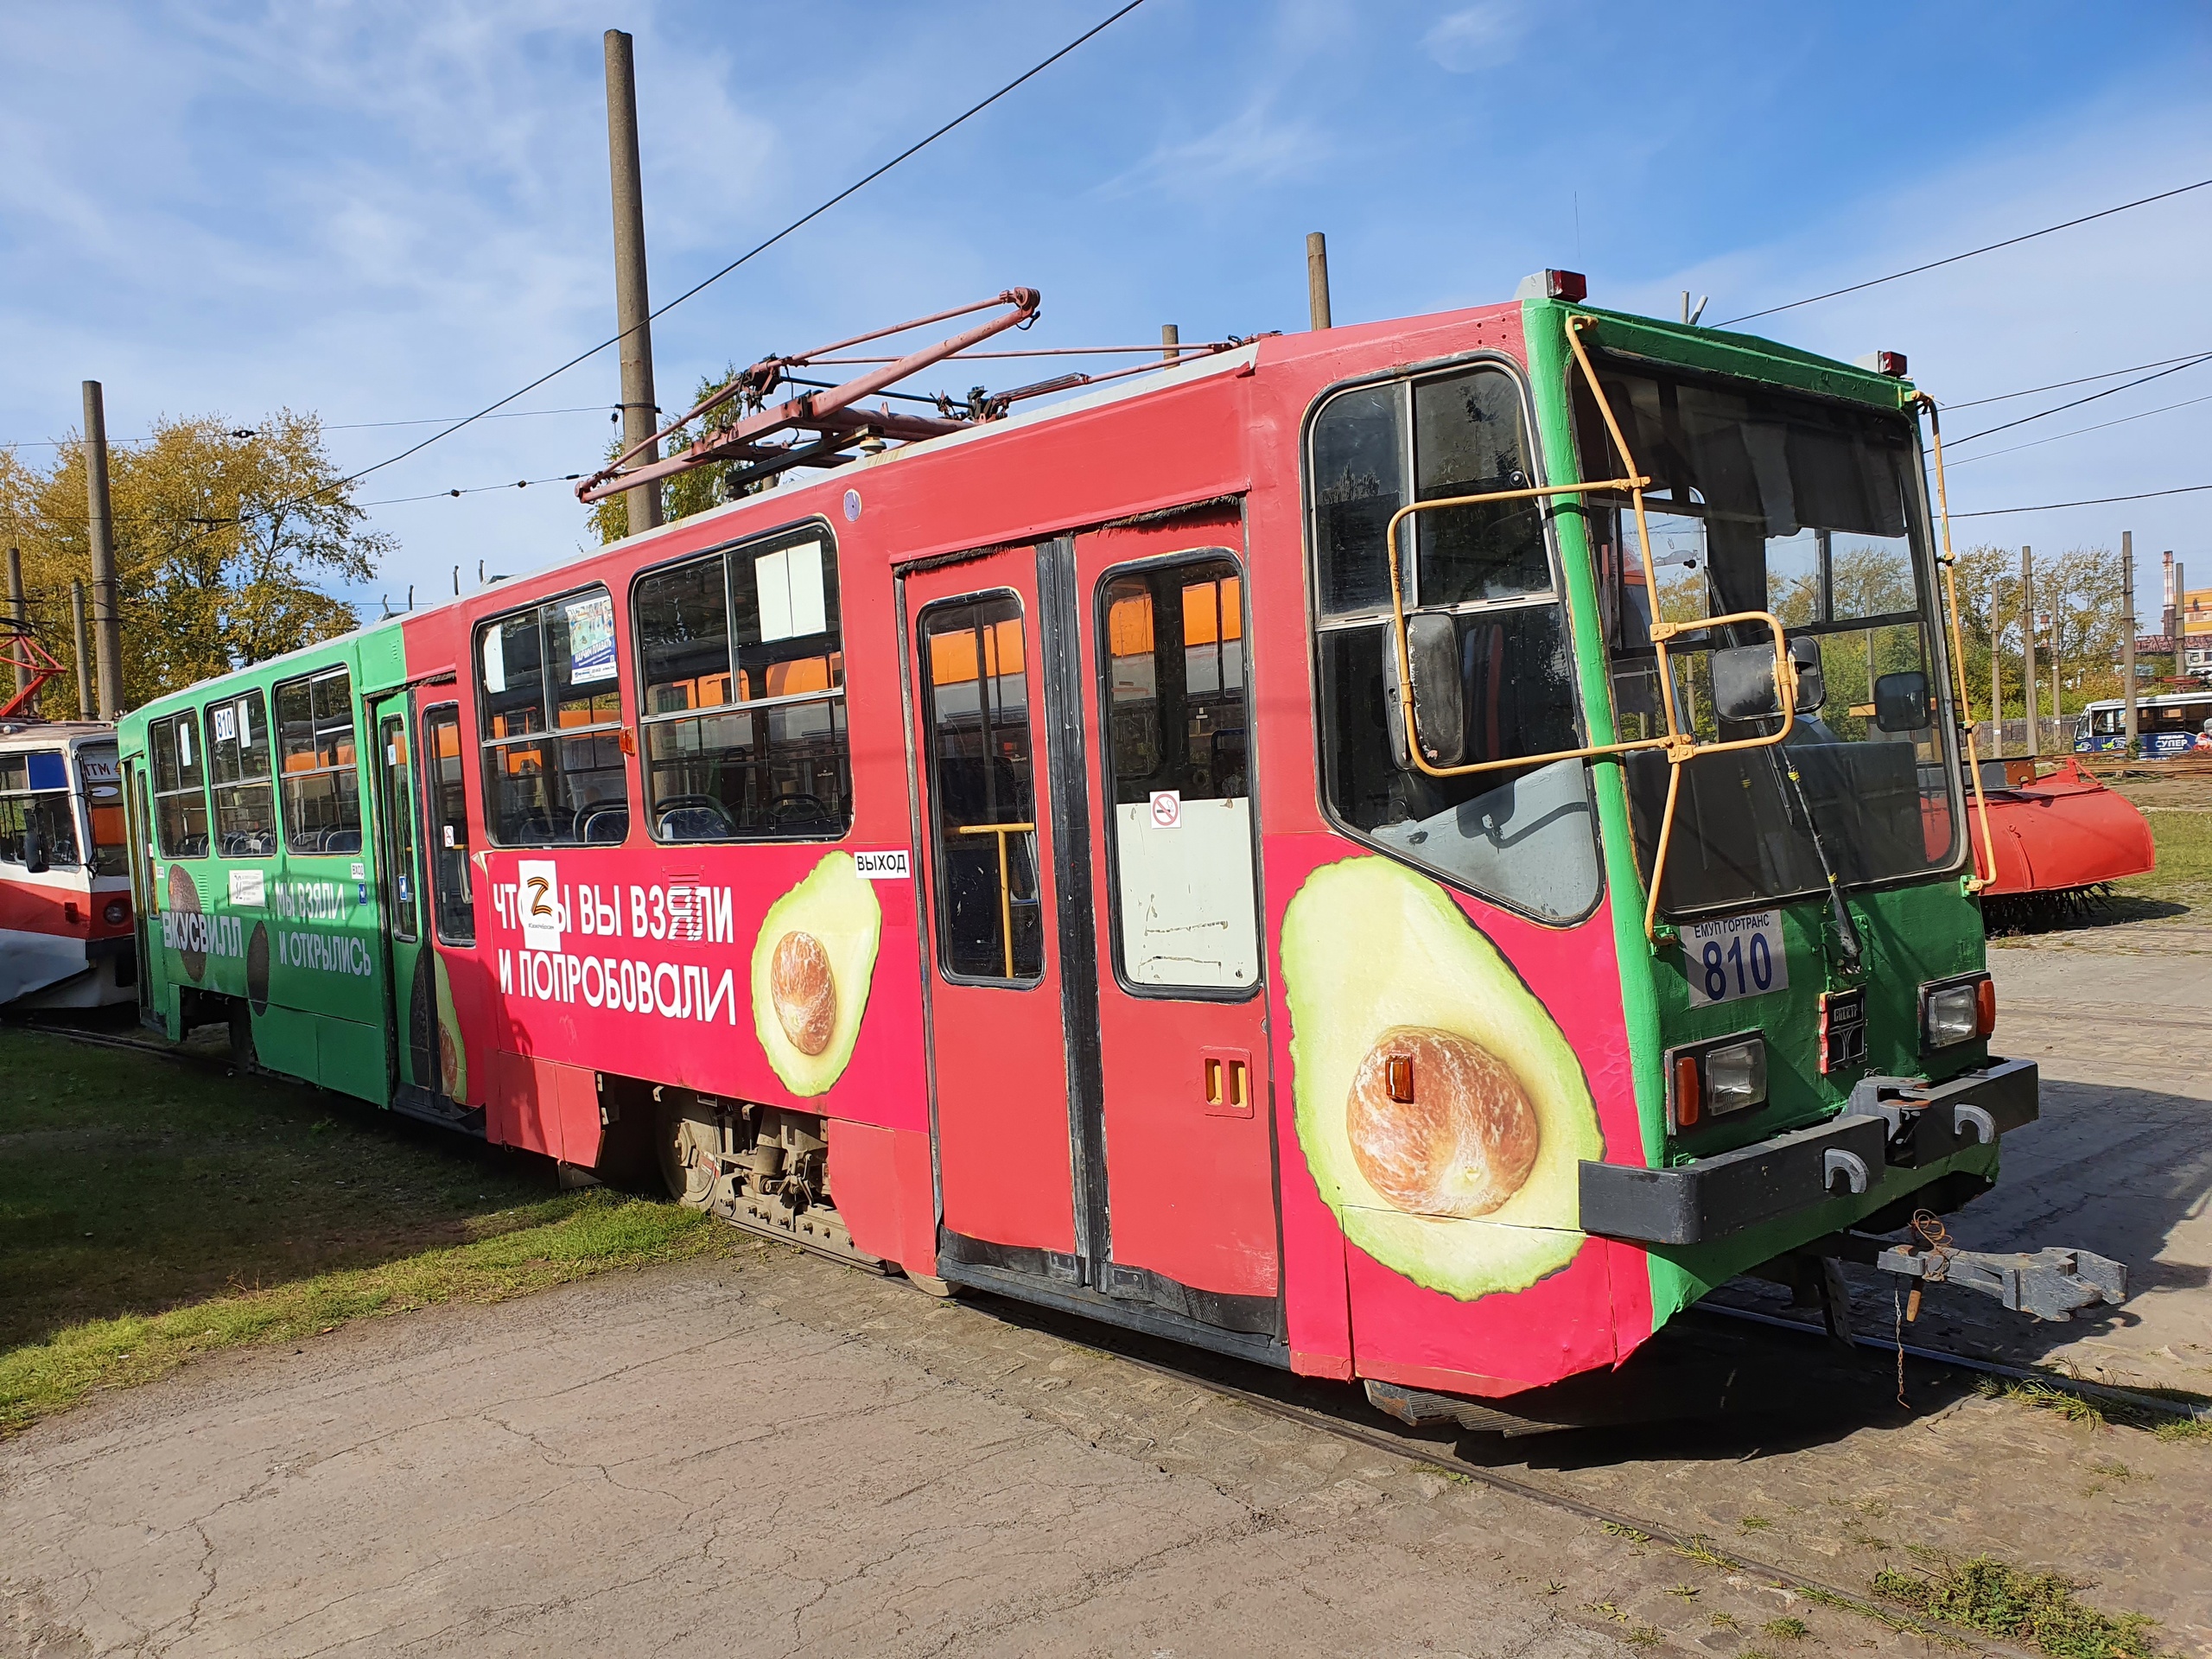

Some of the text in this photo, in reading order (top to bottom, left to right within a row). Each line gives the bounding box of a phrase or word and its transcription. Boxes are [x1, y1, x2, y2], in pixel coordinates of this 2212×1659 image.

[217, 710, 232, 738] 810
[2155, 739, 2188, 747] СУПЕР
[856, 855, 906, 874] ВЫХОД
[275, 882, 296, 917] МЫ
[297, 882, 346, 920] ВЗЯЛИ
[579, 886, 622, 937] ВЫ
[631, 886, 734, 944] ВЗЯЛИ
[162, 912, 244, 958] ВКУСВИЛЛ
[1694, 914, 1770, 938] ЕМУП ГОРТРАНС
[279, 931, 372, 976] И ОТКРЫЛИСЬ
[498, 949, 513, 995] И
[1702, 932, 1772, 1001] 810
